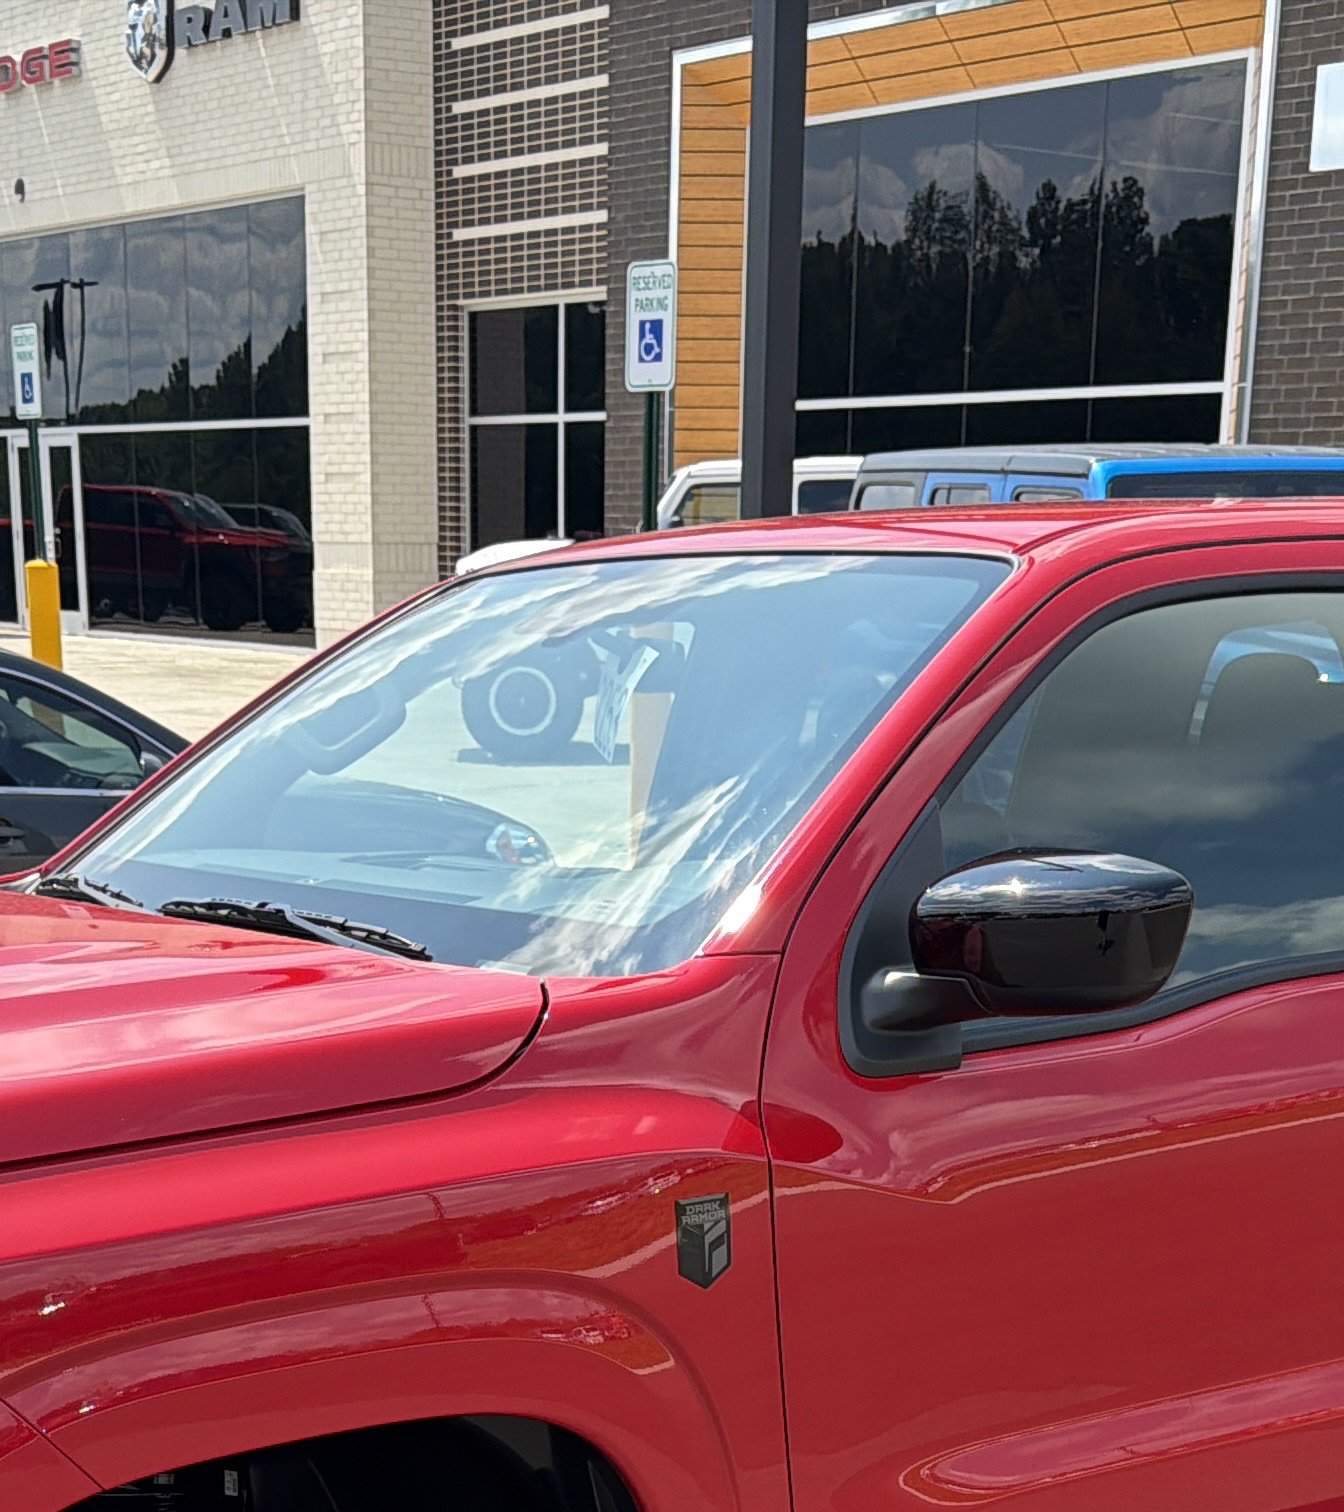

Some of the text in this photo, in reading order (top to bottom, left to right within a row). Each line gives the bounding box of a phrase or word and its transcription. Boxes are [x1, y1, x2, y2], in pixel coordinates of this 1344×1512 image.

[173, 0, 294, 49] RAM
[632, 273, 672, 291] RESERVED
[635, 296, 669, 312] PARKING
[685, 1200, 722, 1215] DARK
[680, 1209, 726, 1225] ARMOR
